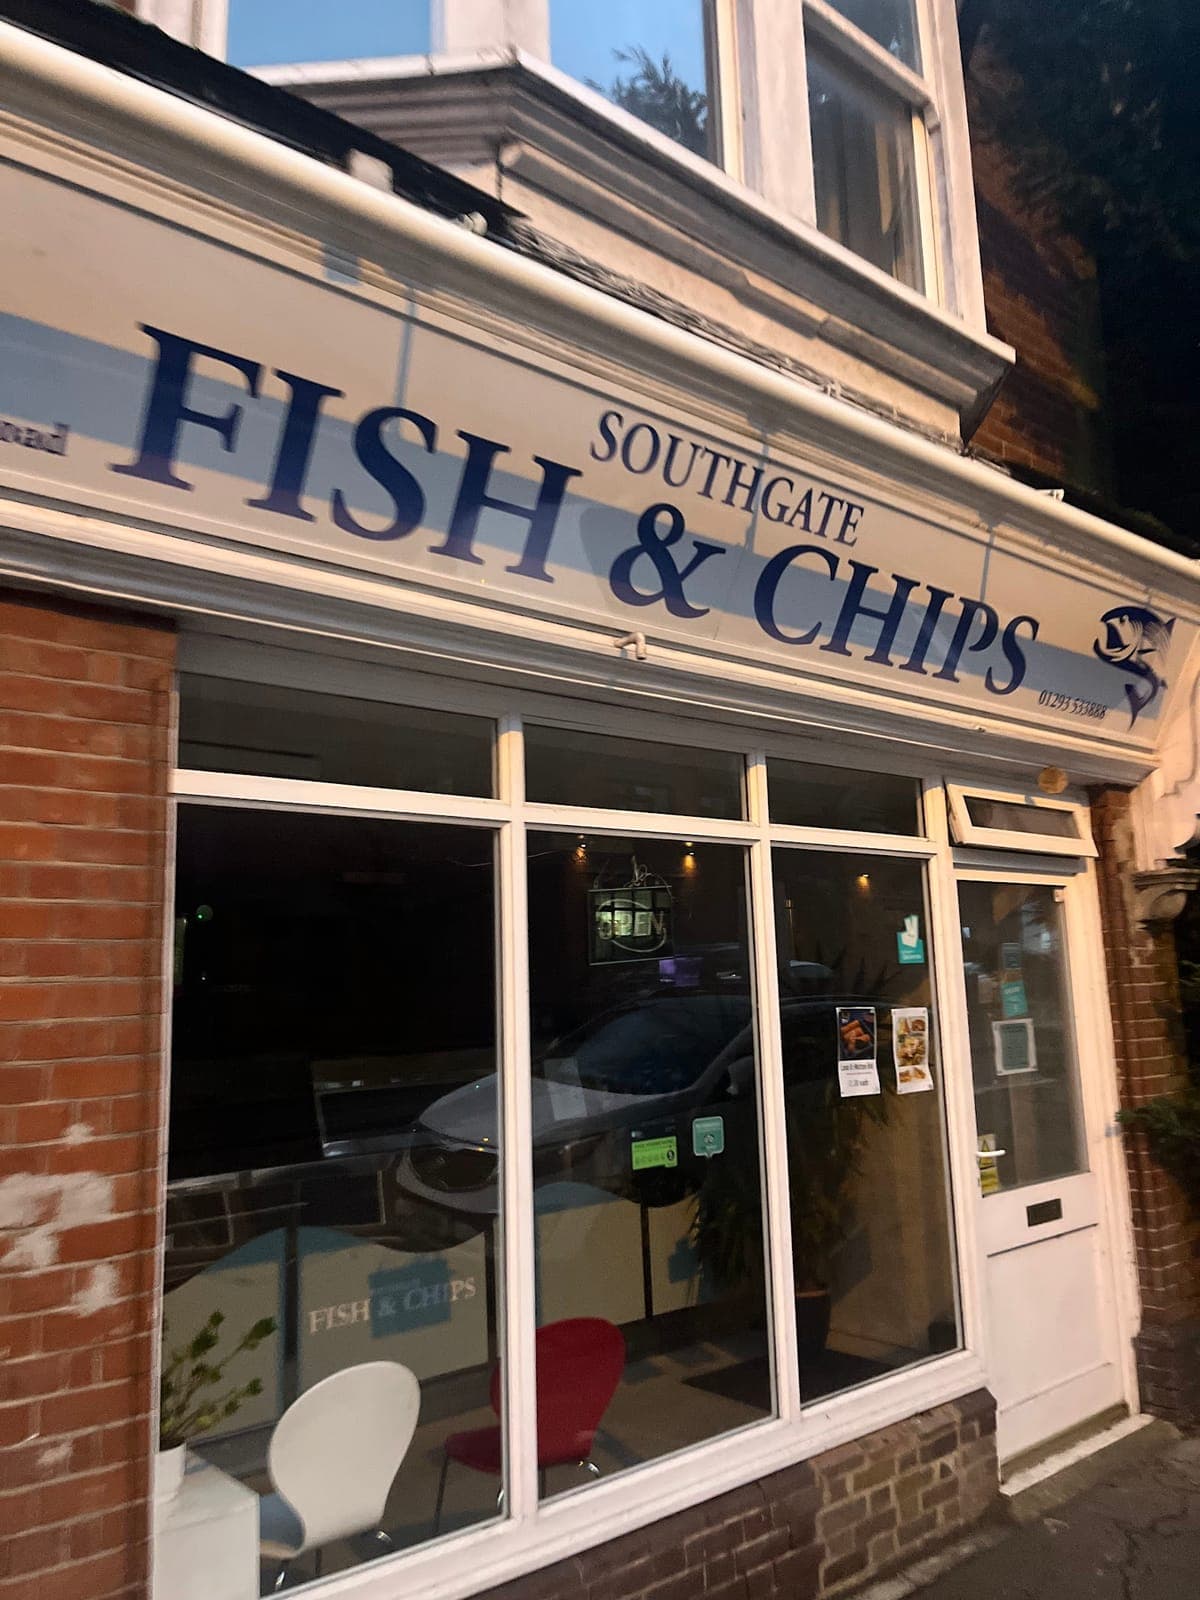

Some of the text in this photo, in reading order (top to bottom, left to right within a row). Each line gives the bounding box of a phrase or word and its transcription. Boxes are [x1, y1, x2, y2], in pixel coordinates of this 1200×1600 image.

[108, 322, 1041, 696] FISH & CHIPS
[590, 410, 865, 547] SOUTHGATE
[1039, 689, 1071, 712] 01293
[308, 1297, 370, 1334] FISH
[403, 1276, 477, 1313] CHIPS
